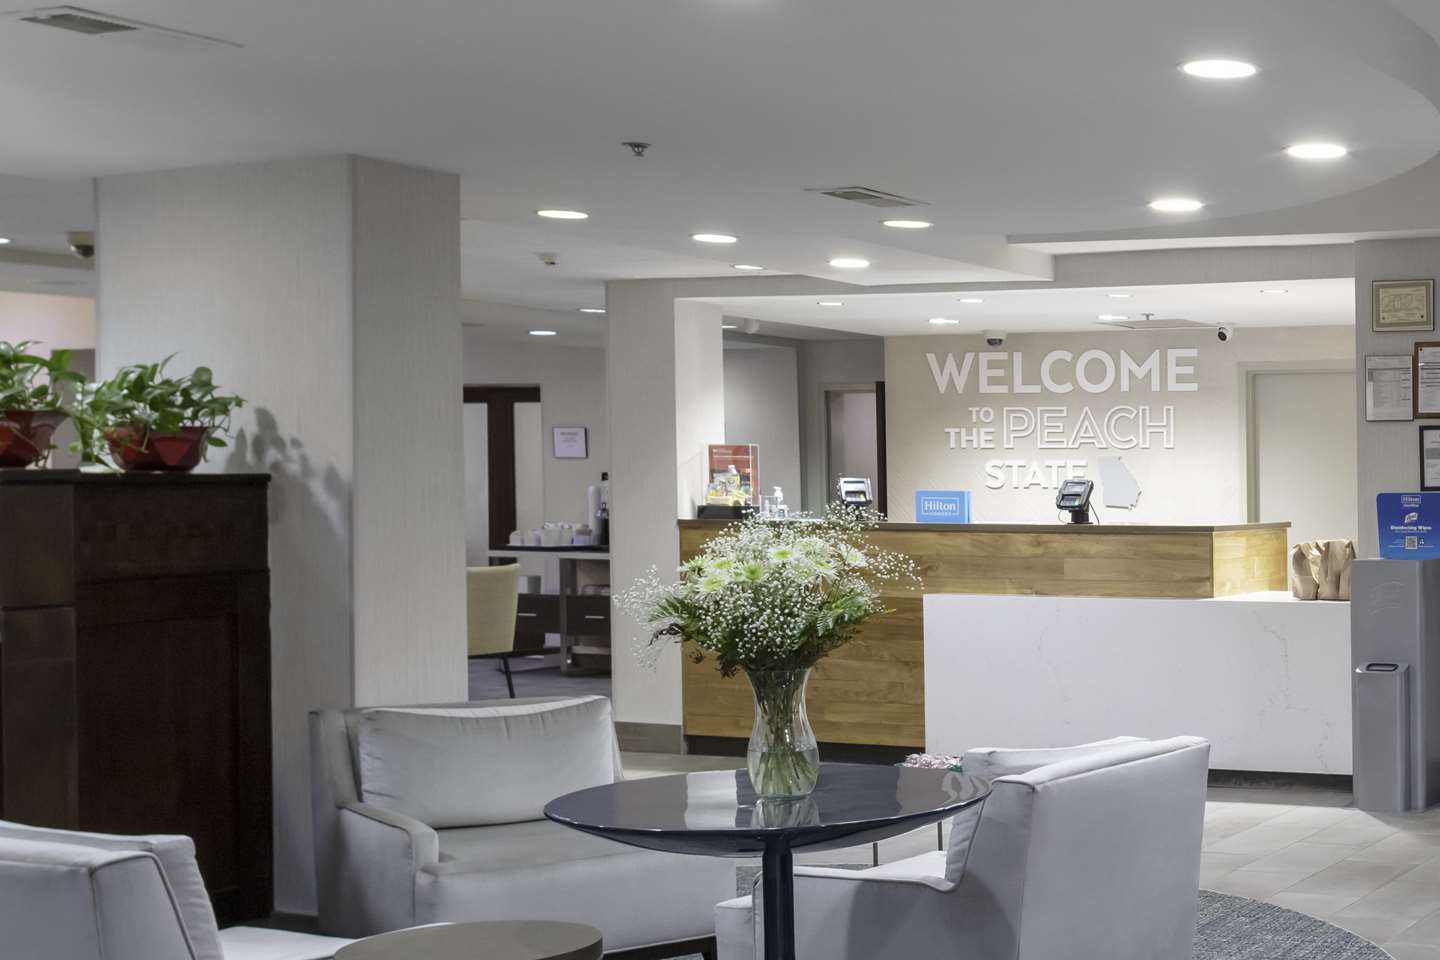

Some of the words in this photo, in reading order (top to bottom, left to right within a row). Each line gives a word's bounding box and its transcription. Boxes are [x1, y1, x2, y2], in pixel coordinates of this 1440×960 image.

[926, 348, 1199, 394] WELCOME
[944, 427, 995, 449] THE
[1003, 405, 1175, 449] PEACH
[968, 407, 994, 423] TO
[985, 459, 1088, 490] STATE
[924, 500, 956, 511] Hilton
